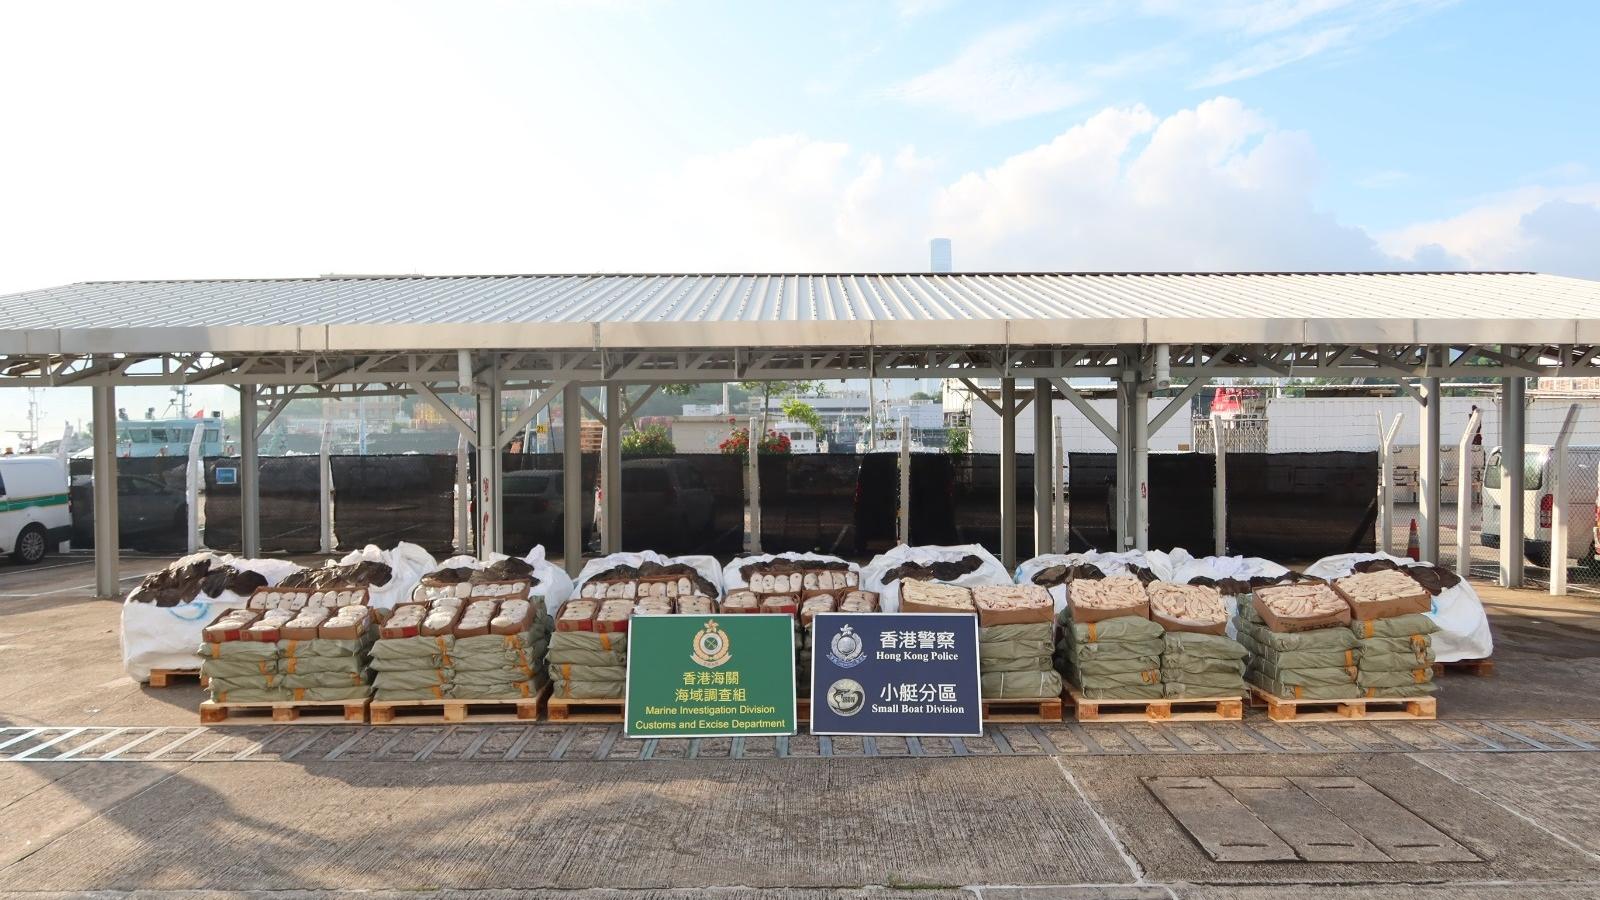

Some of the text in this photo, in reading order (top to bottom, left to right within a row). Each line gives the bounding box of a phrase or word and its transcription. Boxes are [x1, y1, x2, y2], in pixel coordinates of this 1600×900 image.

[879, 630, 956, 649] 香港警察
[876, 651, 902, 662] Hong
[904, 651, 928, 662] Kong
[930, 651, 959, 661] Police
[682, 671, 740, 685] 香港海關
[674, 688, 747, 702] 海域調查組
[879, 683, 958, 702] 小艇分區
[645, 704, 775, 716] Marine Investigation Division
[871, 704, 965, 713] Small Boat Division
[635, 719, 785, 730] Customs and Excise Department
